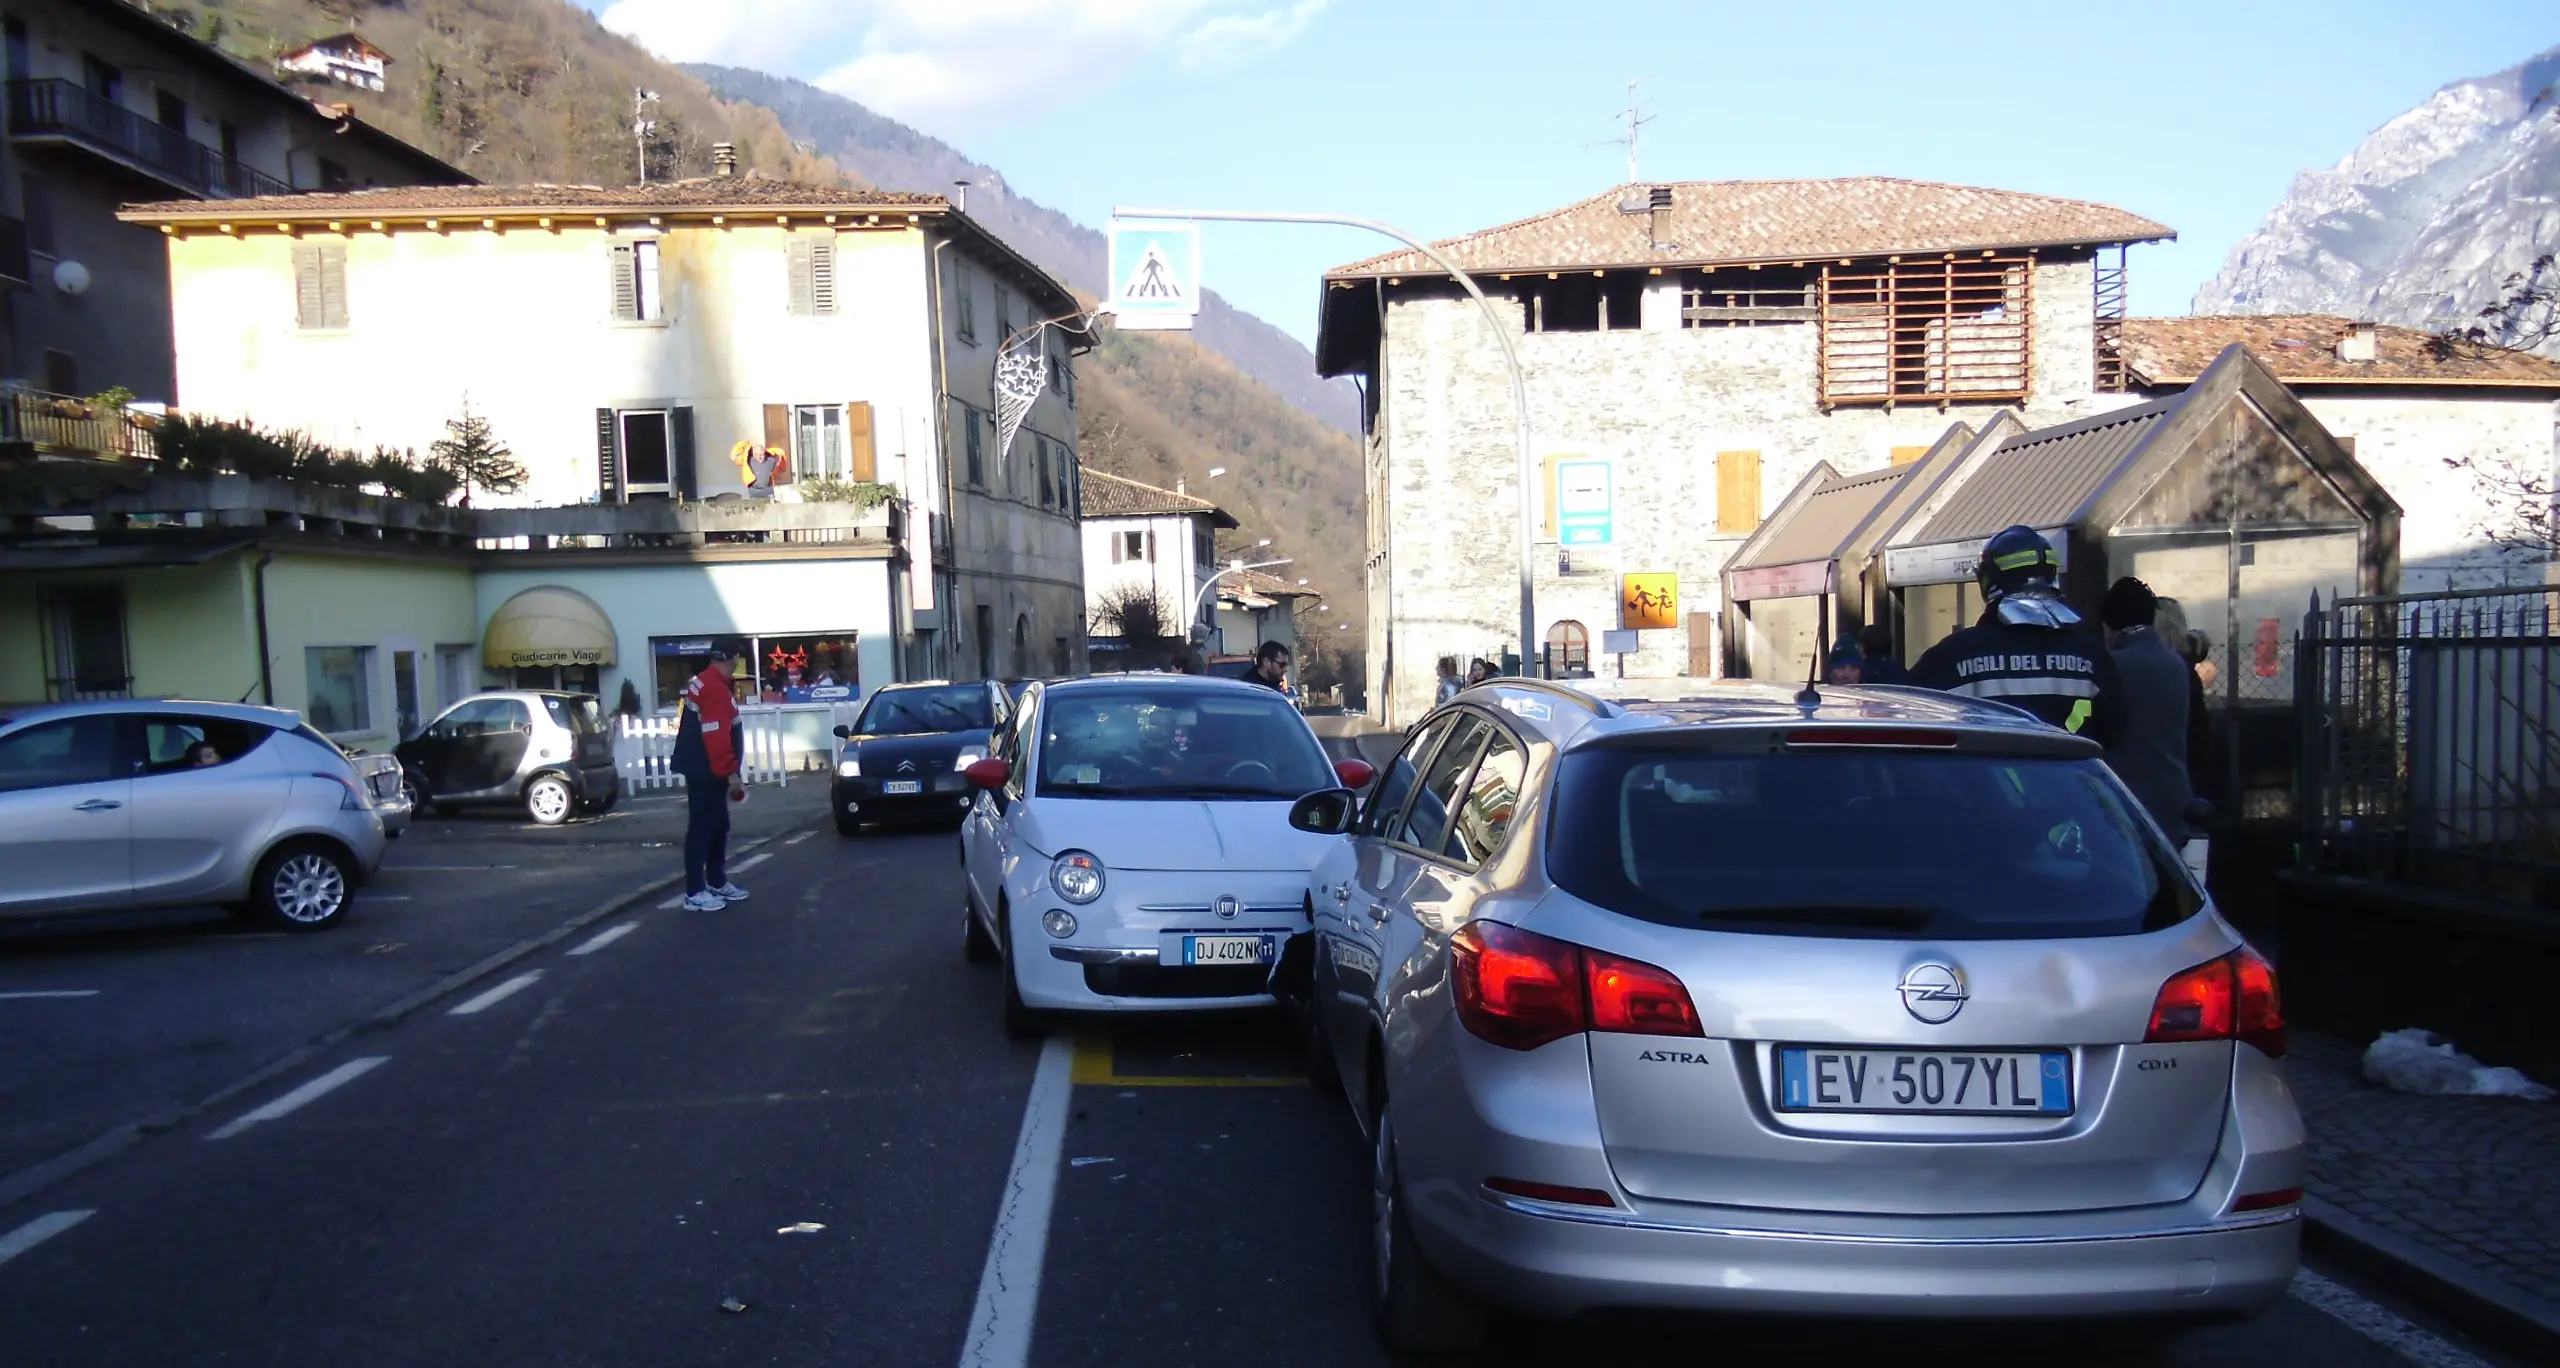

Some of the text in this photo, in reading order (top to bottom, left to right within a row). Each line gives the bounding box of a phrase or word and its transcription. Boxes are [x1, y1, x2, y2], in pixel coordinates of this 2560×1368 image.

[1559, 552, 1569, 563] 73
[511, 651, 567, 662] Giudicarie
[1956, 655, 2004, 677] VIGILI
[2010, 655, 2040, 671] DEL
[1197, 942, 1213, 960] DJ
[1219, 942, 1262, 959] 402NK
[1639, 1050, 1709, 1065] ASTRA
[1814, 1054, 1868, 1104] EV
[1891, 1056, 2037, 1107] 507YL
